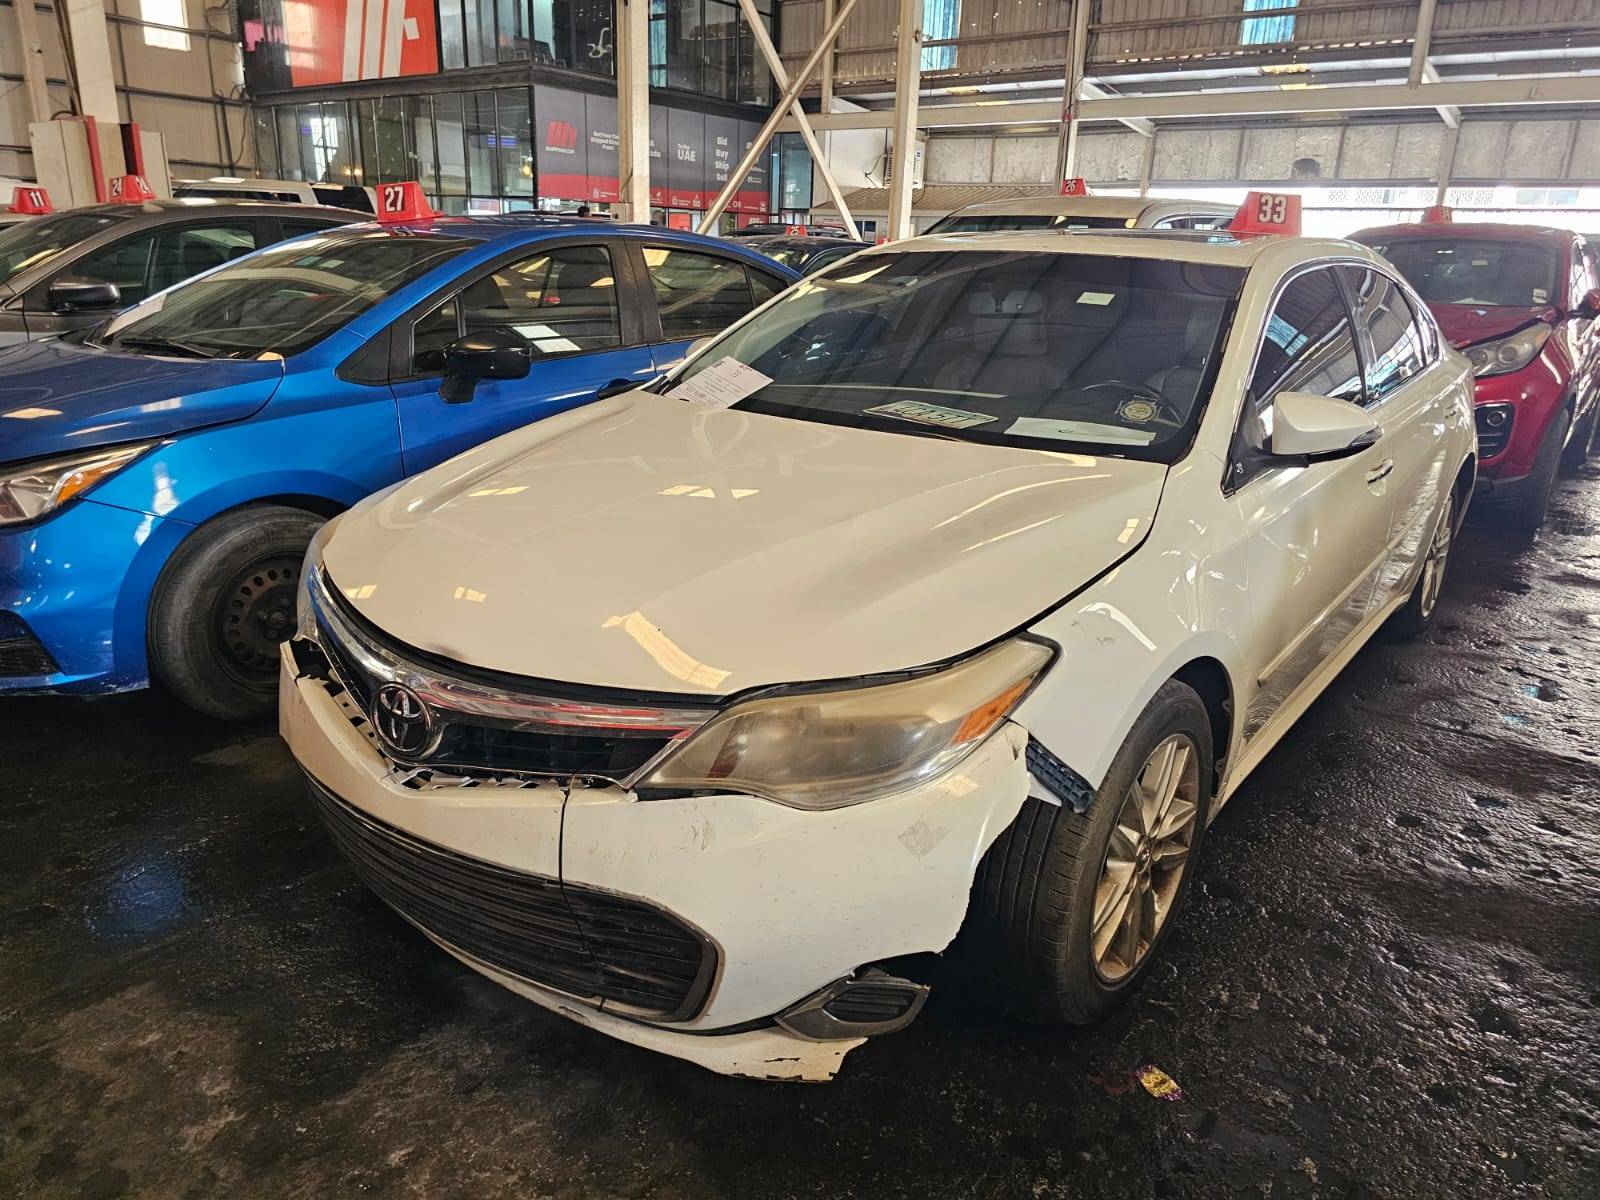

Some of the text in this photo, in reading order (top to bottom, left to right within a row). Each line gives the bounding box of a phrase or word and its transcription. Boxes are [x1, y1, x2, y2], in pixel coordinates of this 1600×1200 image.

[717, 136, 728, 146] Bid
[677, 149, 696, 162] UAE
[715, 149, 729, 160] Buy
[715, 161, 730, 172] Ship
[716, 173, 728, 182] Sell
[112, 179, 122, 196] 24
[1065, 180, 1077, 192] 26
[30, 191, 44, 207] 11
[385, 186, 403, 212] 27
[1258, 194, 1287, 223] 33
